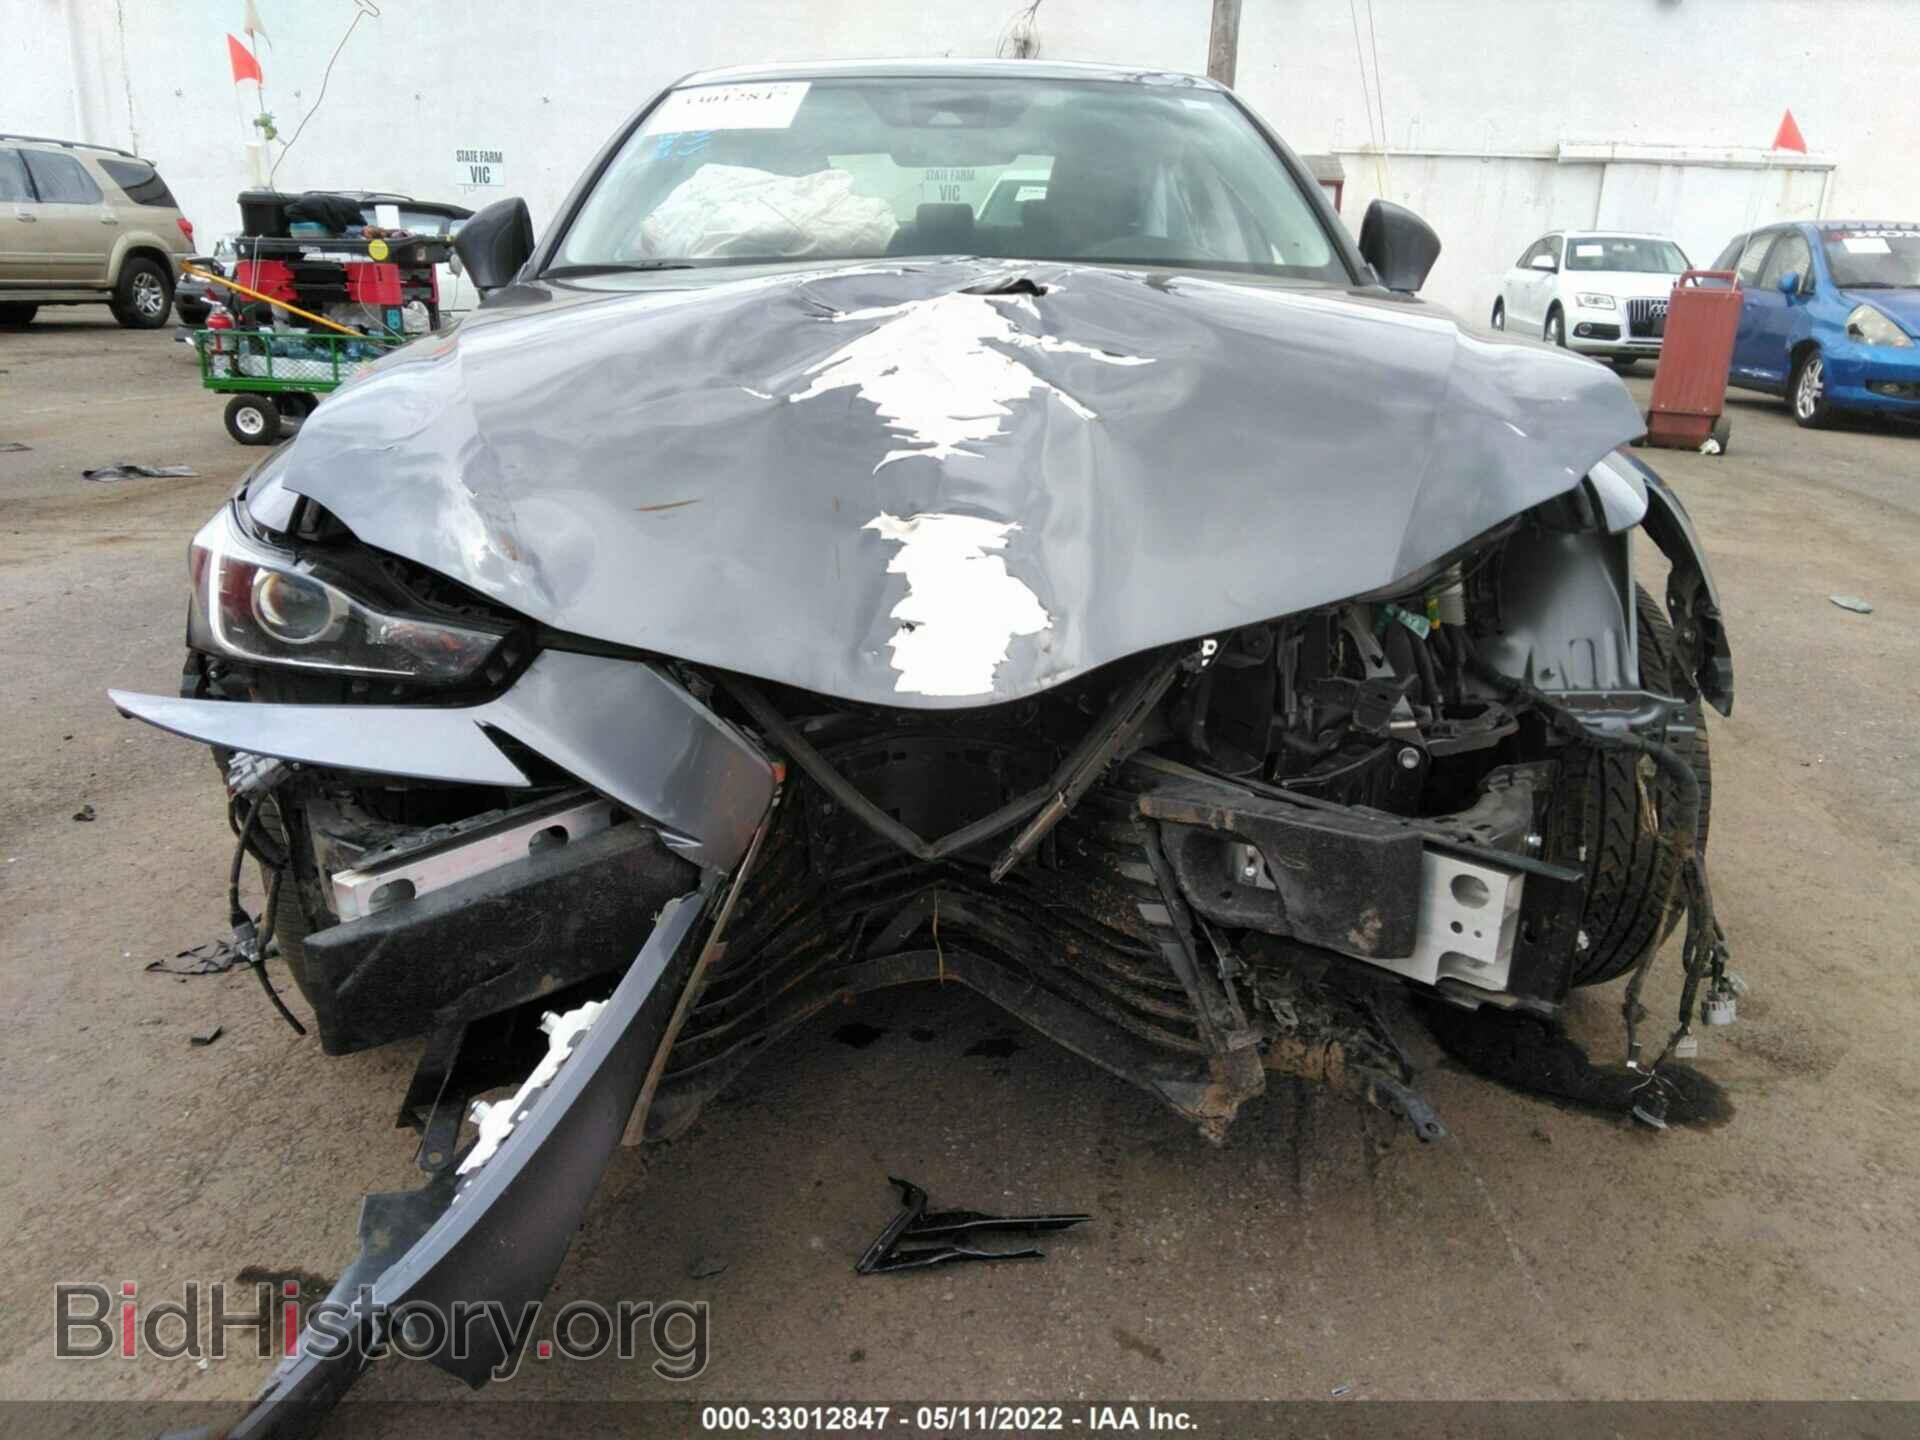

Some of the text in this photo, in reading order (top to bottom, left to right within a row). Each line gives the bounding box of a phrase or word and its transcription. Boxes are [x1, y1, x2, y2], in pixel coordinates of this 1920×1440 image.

[456, 150, 503, 164] STATE FARM
[470, 166, 490, 184] VIC
[939, 184, 960, 202] VIC
